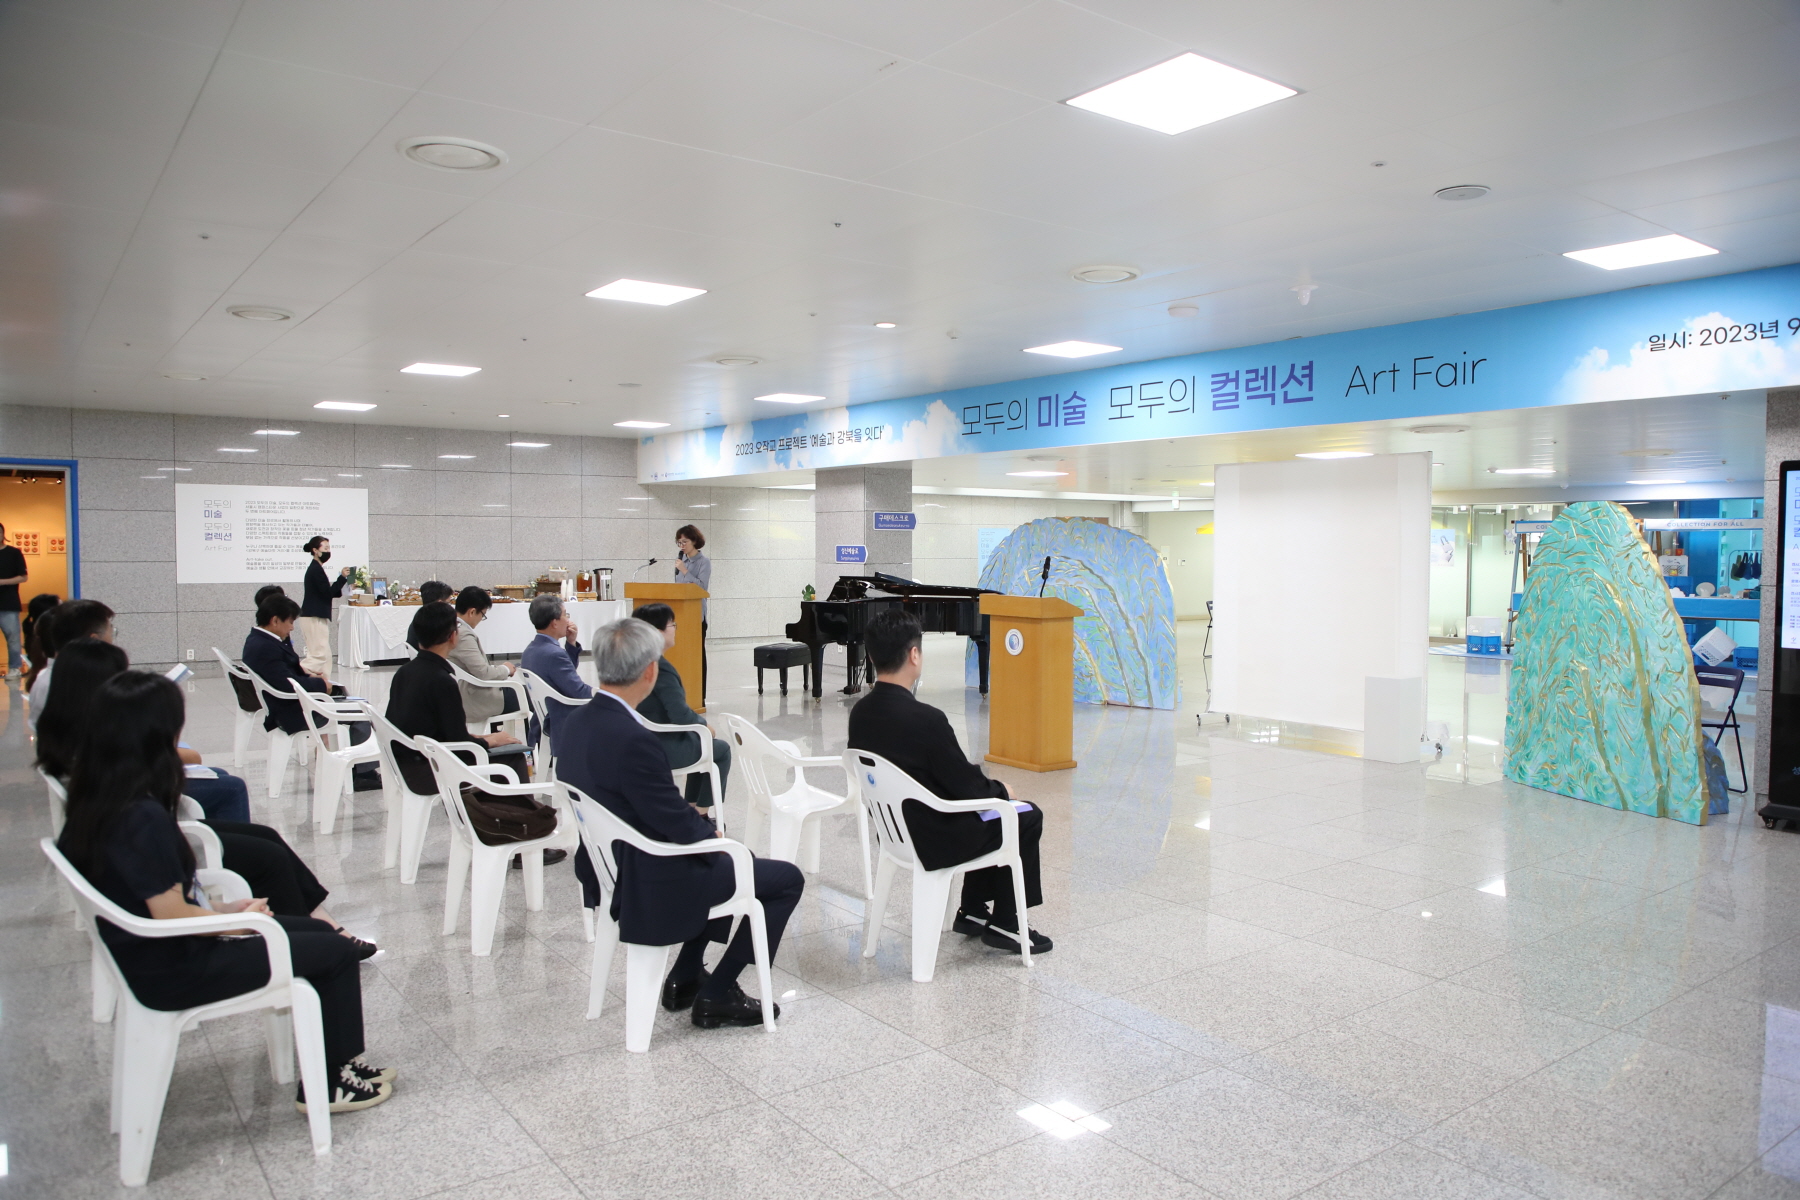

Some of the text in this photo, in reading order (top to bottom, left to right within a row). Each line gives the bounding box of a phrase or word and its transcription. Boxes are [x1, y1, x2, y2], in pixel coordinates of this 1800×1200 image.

[1648, 331, 1692, 352] 일시:
[1700, 319, 1780, 347] 2023년
[1345, 351, 1488, 397] Art Fair
[962, 360, 1314, 436] 모두의 미술 모두의 컬렉션
[736, 442, 754, 456] 2023
[756, 440, 776, 454] 오작교
[778, 436, 807, 451] 프로젝트
[837, 428, 862, 444] 강북을
[204, 500, 232, 508] 모두의
[204, 510, 222, 518] 미술
[204, 522, 231, 531] 모두의
[204, 532, 232, 541] 컬렉션
